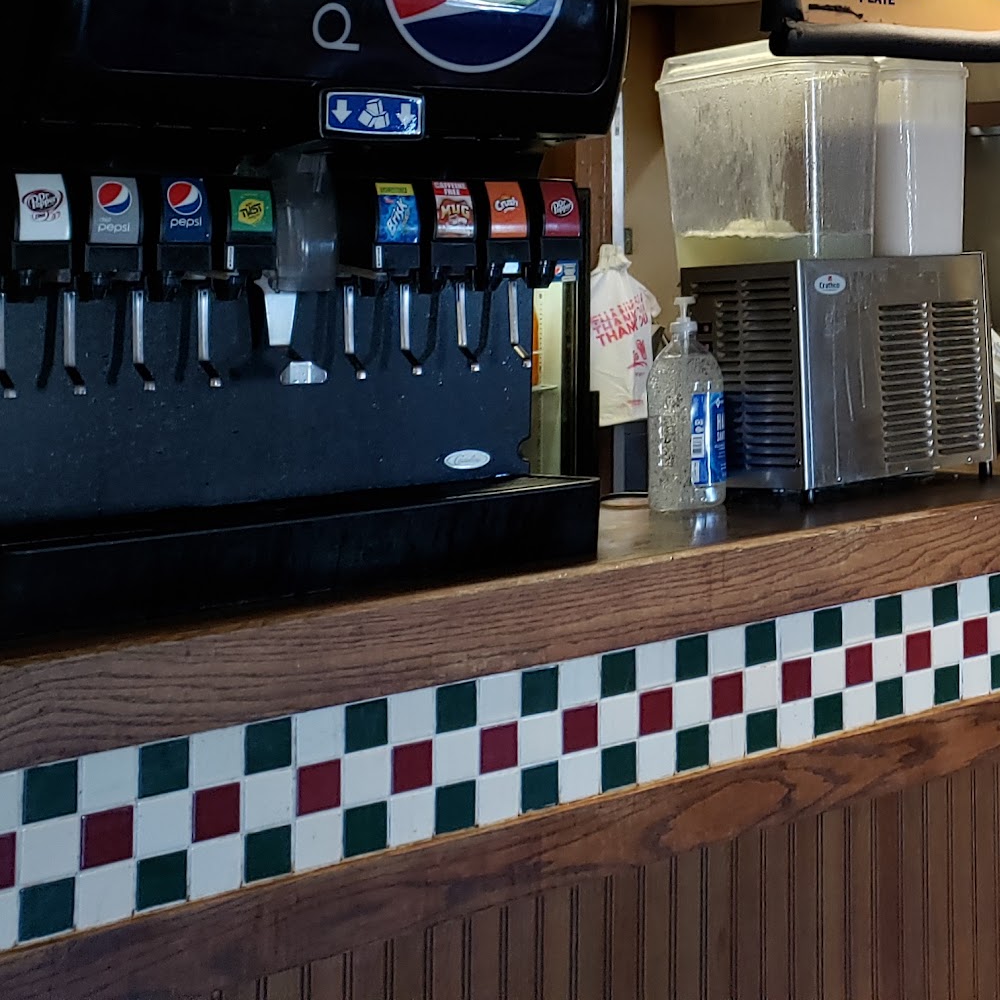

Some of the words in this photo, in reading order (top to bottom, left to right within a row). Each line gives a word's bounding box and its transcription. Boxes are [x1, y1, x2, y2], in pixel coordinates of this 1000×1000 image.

[440, 204, 470, 220] MUG
[98, 222, 131, 233] pepsi
[170, 216, 202, 229] pepsi
